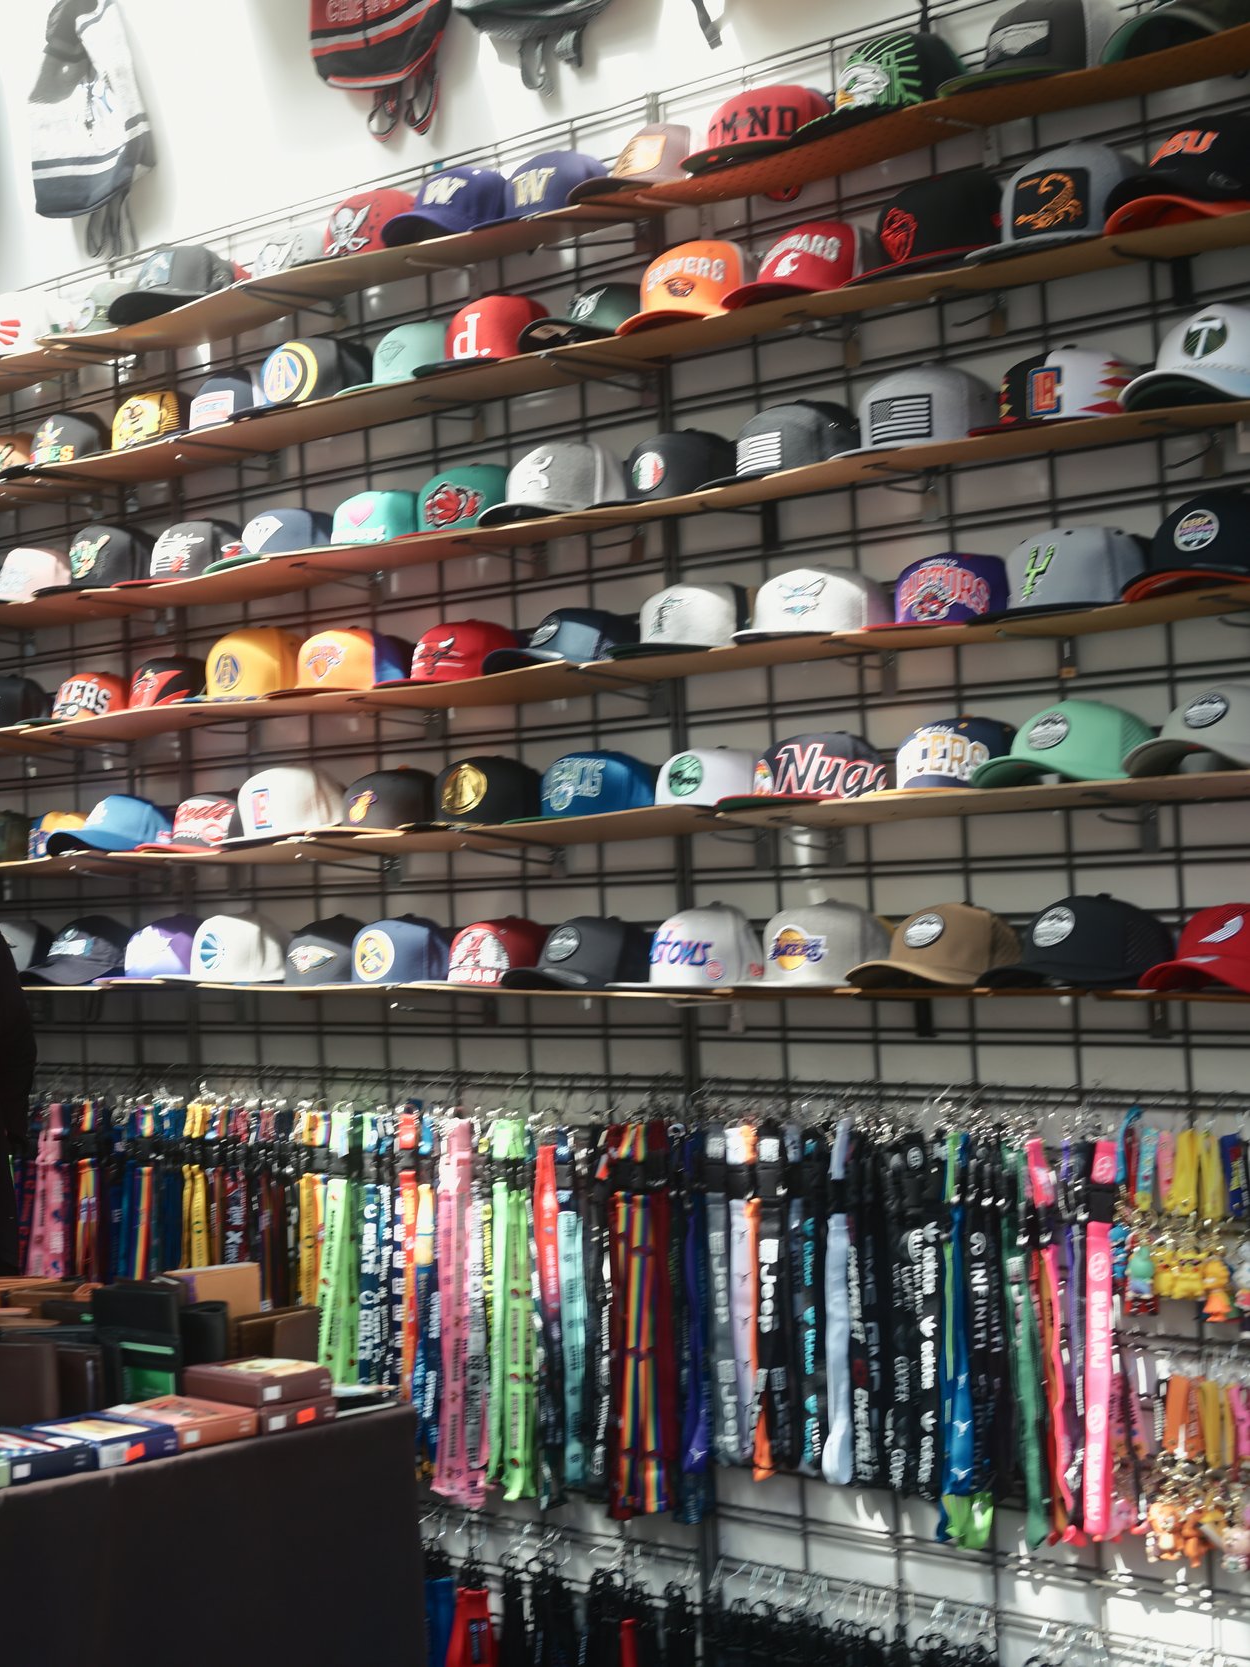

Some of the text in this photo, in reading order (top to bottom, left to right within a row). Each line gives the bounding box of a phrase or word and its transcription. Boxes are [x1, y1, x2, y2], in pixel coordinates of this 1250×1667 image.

[711, 1255, 739, 1453] Jeep Jeep
[757, 1263, 779, 1334] Jeep
[970, 1261, 989, 1350] INFINITI
[1086, 1290, 1107, 1522] SUBARU SUBARU
